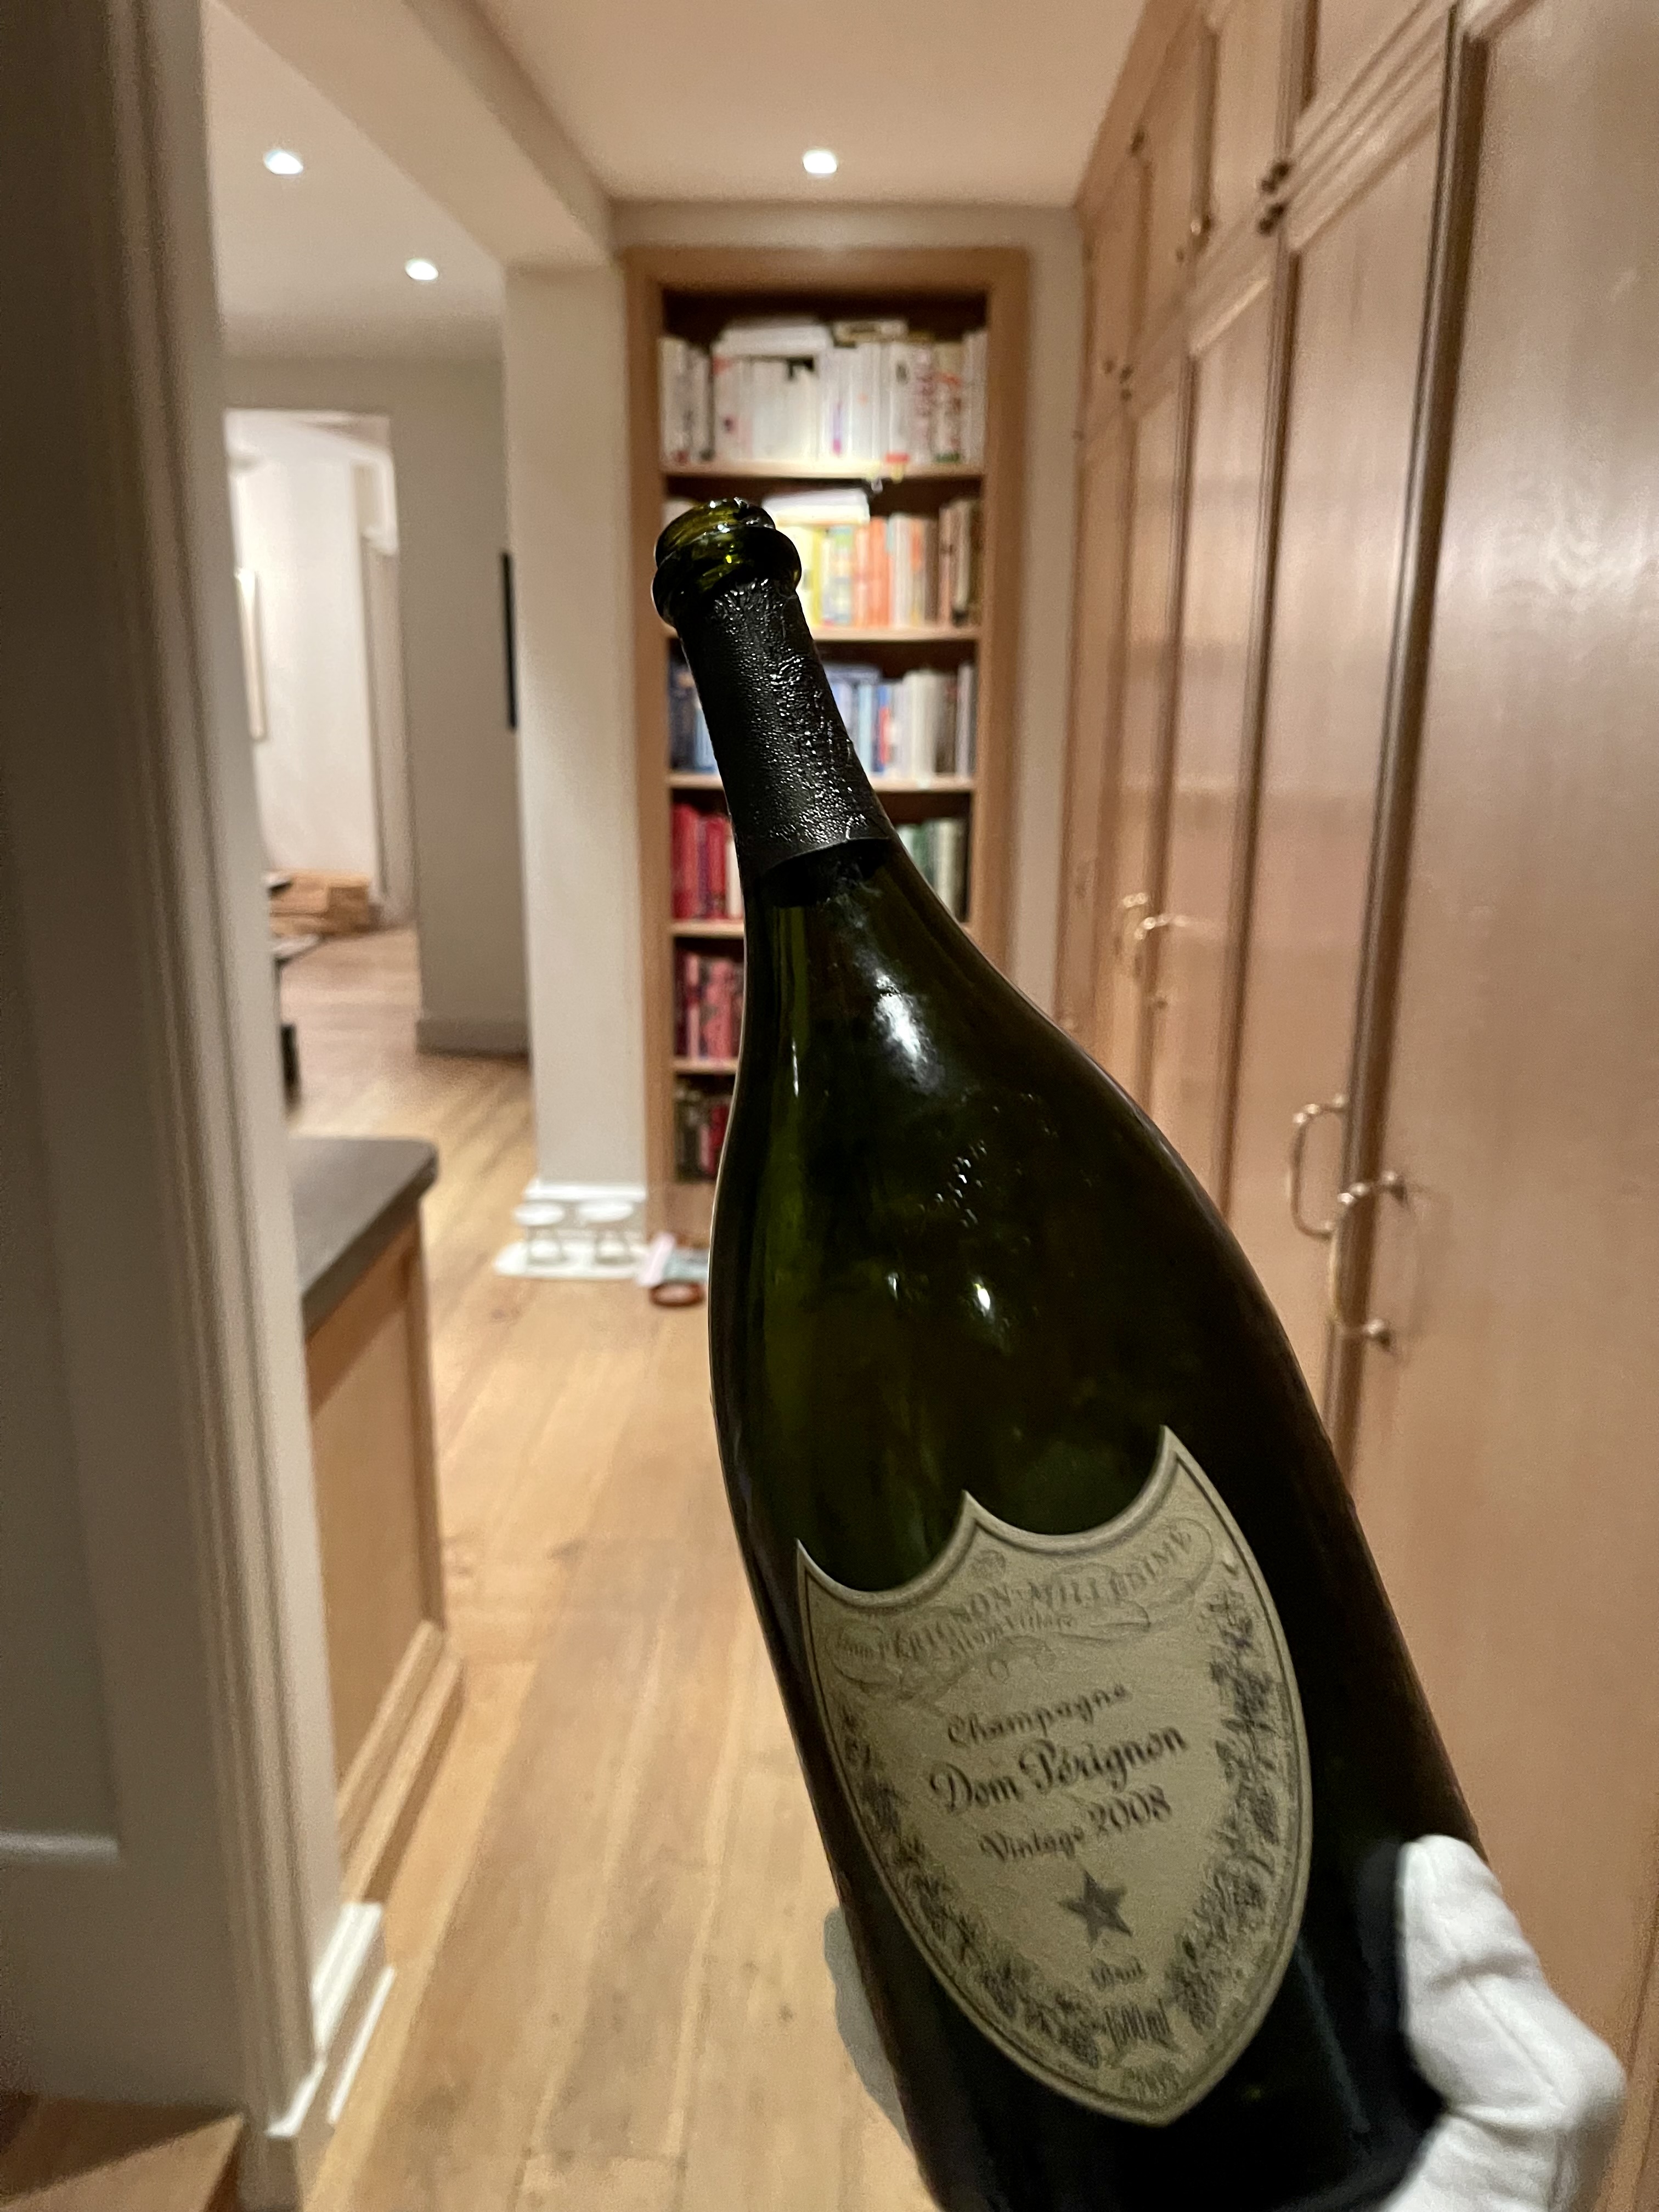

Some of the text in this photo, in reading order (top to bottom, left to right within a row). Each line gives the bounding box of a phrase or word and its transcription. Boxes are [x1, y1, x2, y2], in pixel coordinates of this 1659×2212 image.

[947, 1683, 1130, 1748] Champagne
[929, 1726, 1188, 1811] Dom Pérignon
[979, 1783, 1172, 1862] Vintage 2008
